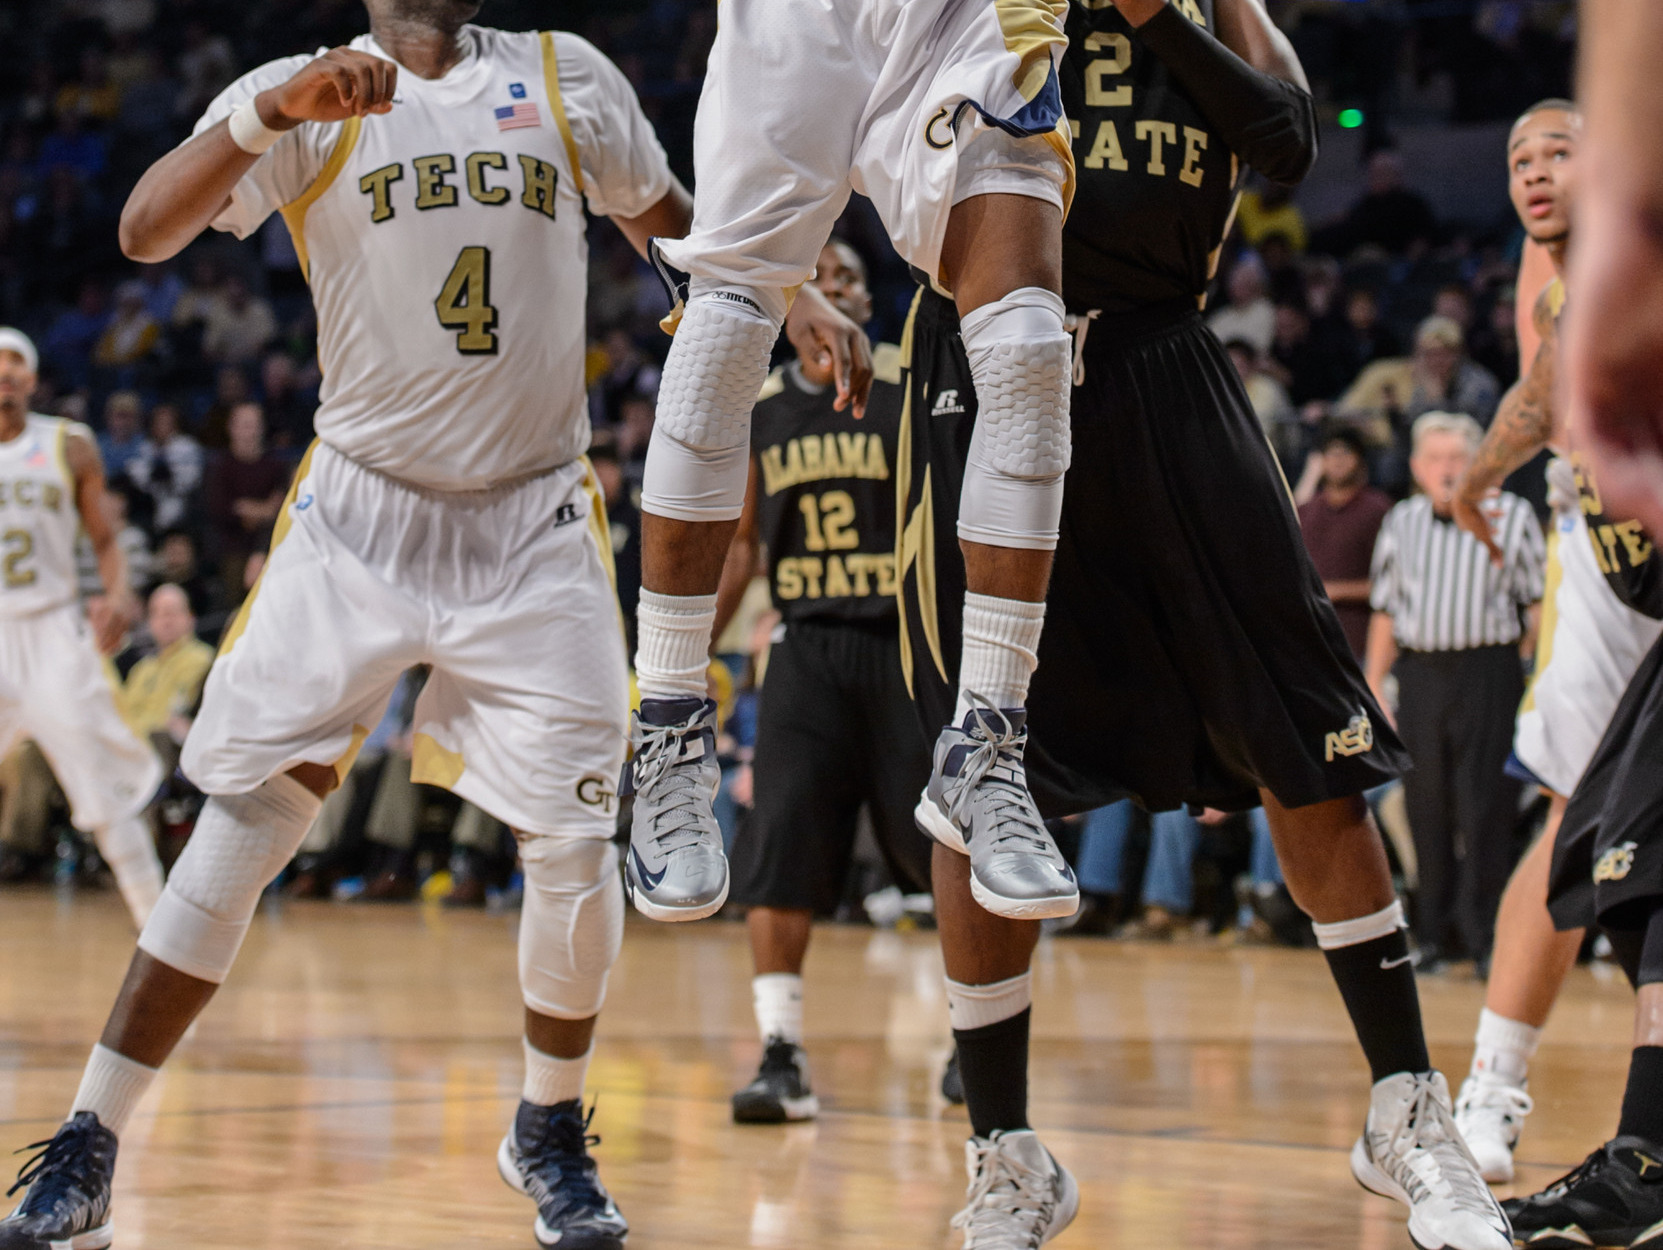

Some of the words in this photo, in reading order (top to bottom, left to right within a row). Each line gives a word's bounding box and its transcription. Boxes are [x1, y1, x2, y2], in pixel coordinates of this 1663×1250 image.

[1084, 31, 1133, 107] 2
[359, 152, 558, 224] TECH
[434, 246, 499, 356] 4
[761, 432, 889, 497] ALABAMA
[799, 490, 860, 551] 12
[777, 554, 897, 600] STATE
[576, 776, 614, 814] GT
